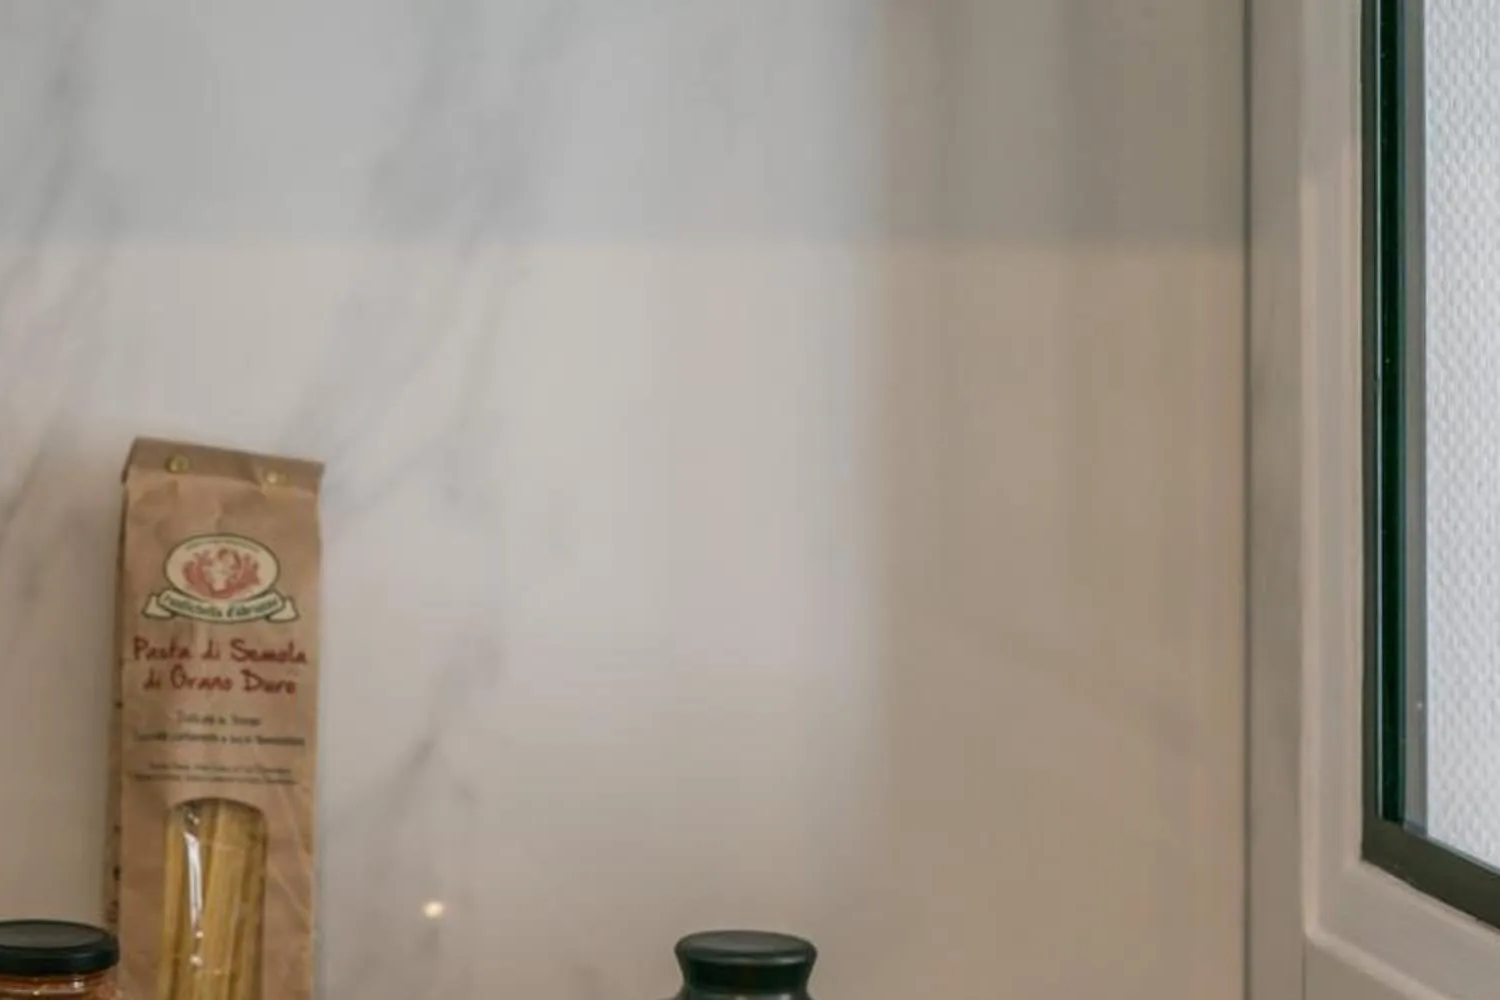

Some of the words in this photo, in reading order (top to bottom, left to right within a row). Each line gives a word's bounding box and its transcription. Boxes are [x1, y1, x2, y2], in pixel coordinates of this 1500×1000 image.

[132, 636, 191, 661] Pasta
[202, 639, 220, 661] di
[230, 638, 307, 663] Semola
[143, 668, 161, 690] di
[169, 663, 233, 690] Grano
[240, 668, 297, 694] Duro
